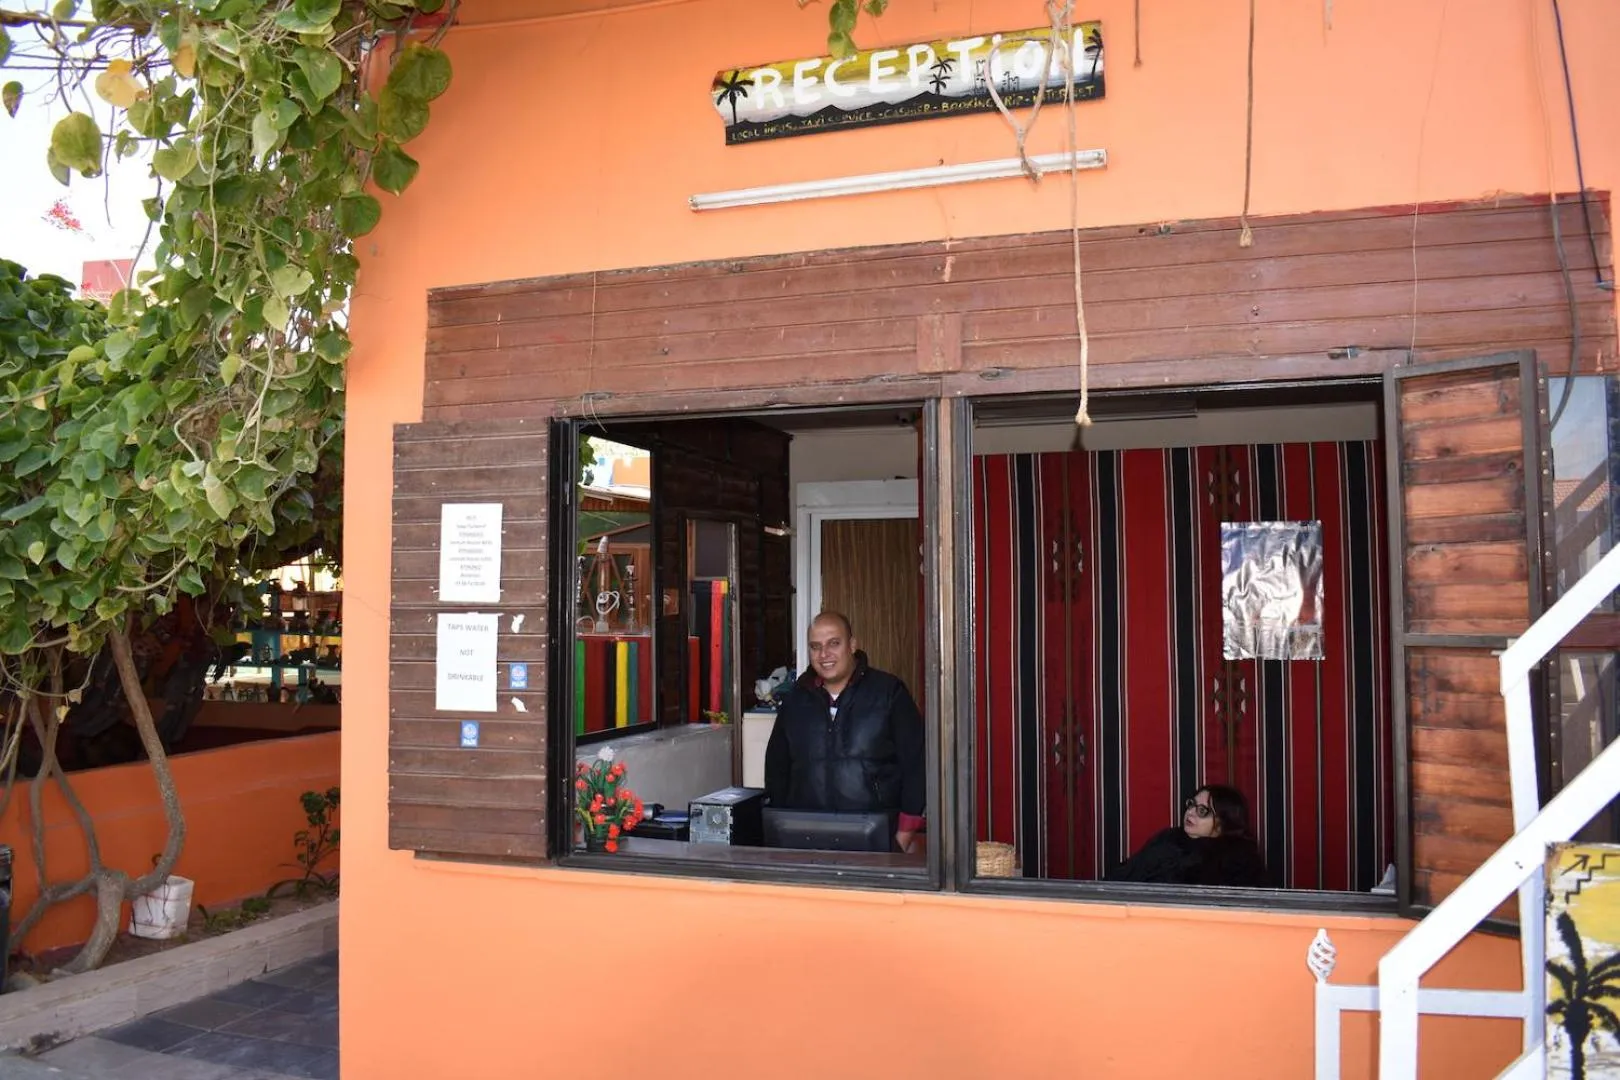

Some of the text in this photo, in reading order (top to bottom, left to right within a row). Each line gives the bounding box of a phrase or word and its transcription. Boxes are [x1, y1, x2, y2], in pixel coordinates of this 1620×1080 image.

[465, 623, 489, 632] WATER
[459, 648, 474, 657] NOT
[447, 672, 484, 682] DRINKABLE
